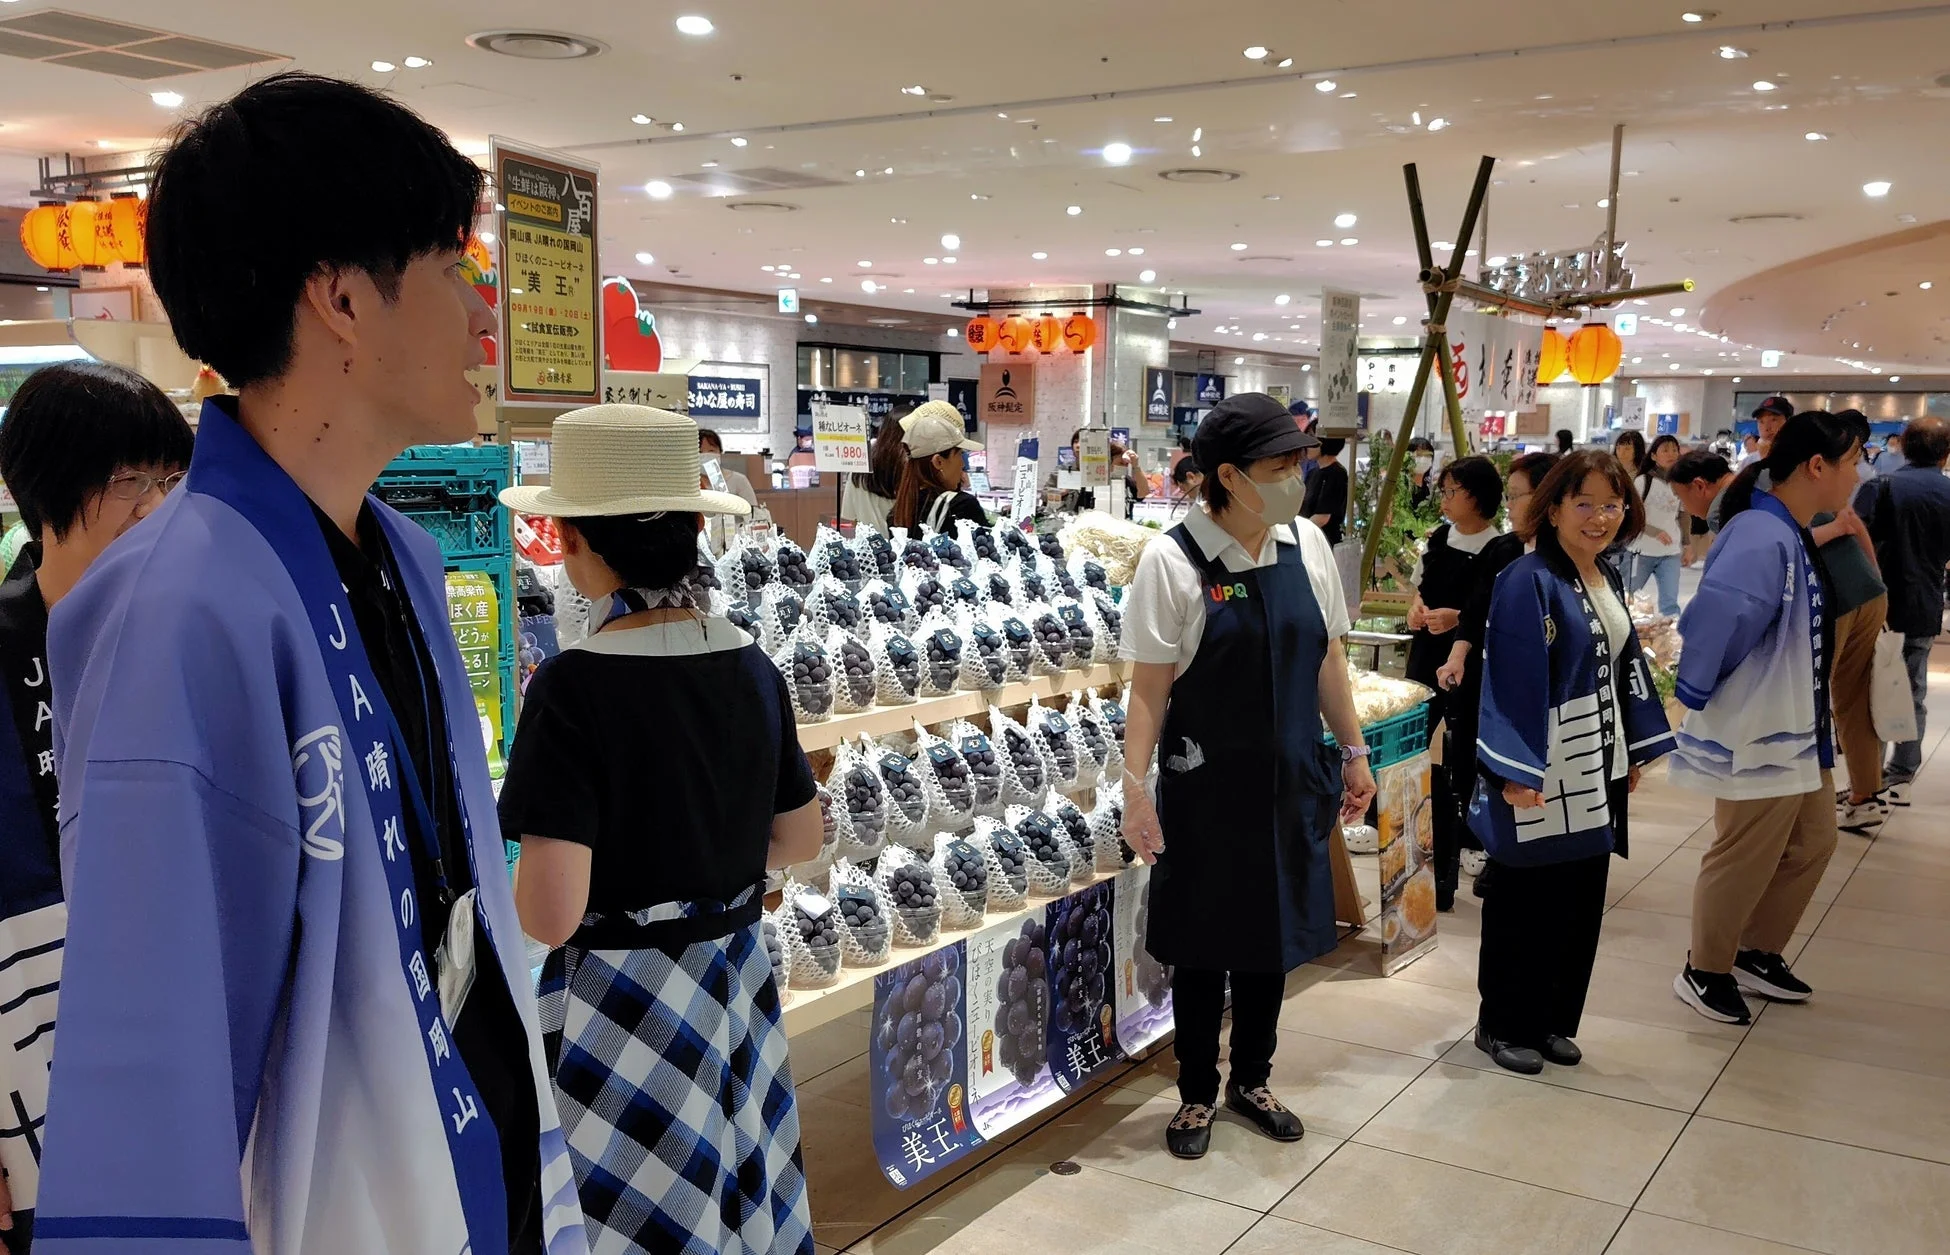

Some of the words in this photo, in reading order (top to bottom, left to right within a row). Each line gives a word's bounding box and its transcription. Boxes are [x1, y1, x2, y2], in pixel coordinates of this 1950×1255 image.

[510, 199, 559, 217] イベントのご案内
[561, 171, 593, 237] 八百屋
[509, 229, 532, 244] 岡山県
[534, 234, 584, 253] JA晴れの国岡山
[818, 421, 862, 433] 種なしピオーネ
[328, 603, 479, 1135] JA晴れの国岡山
